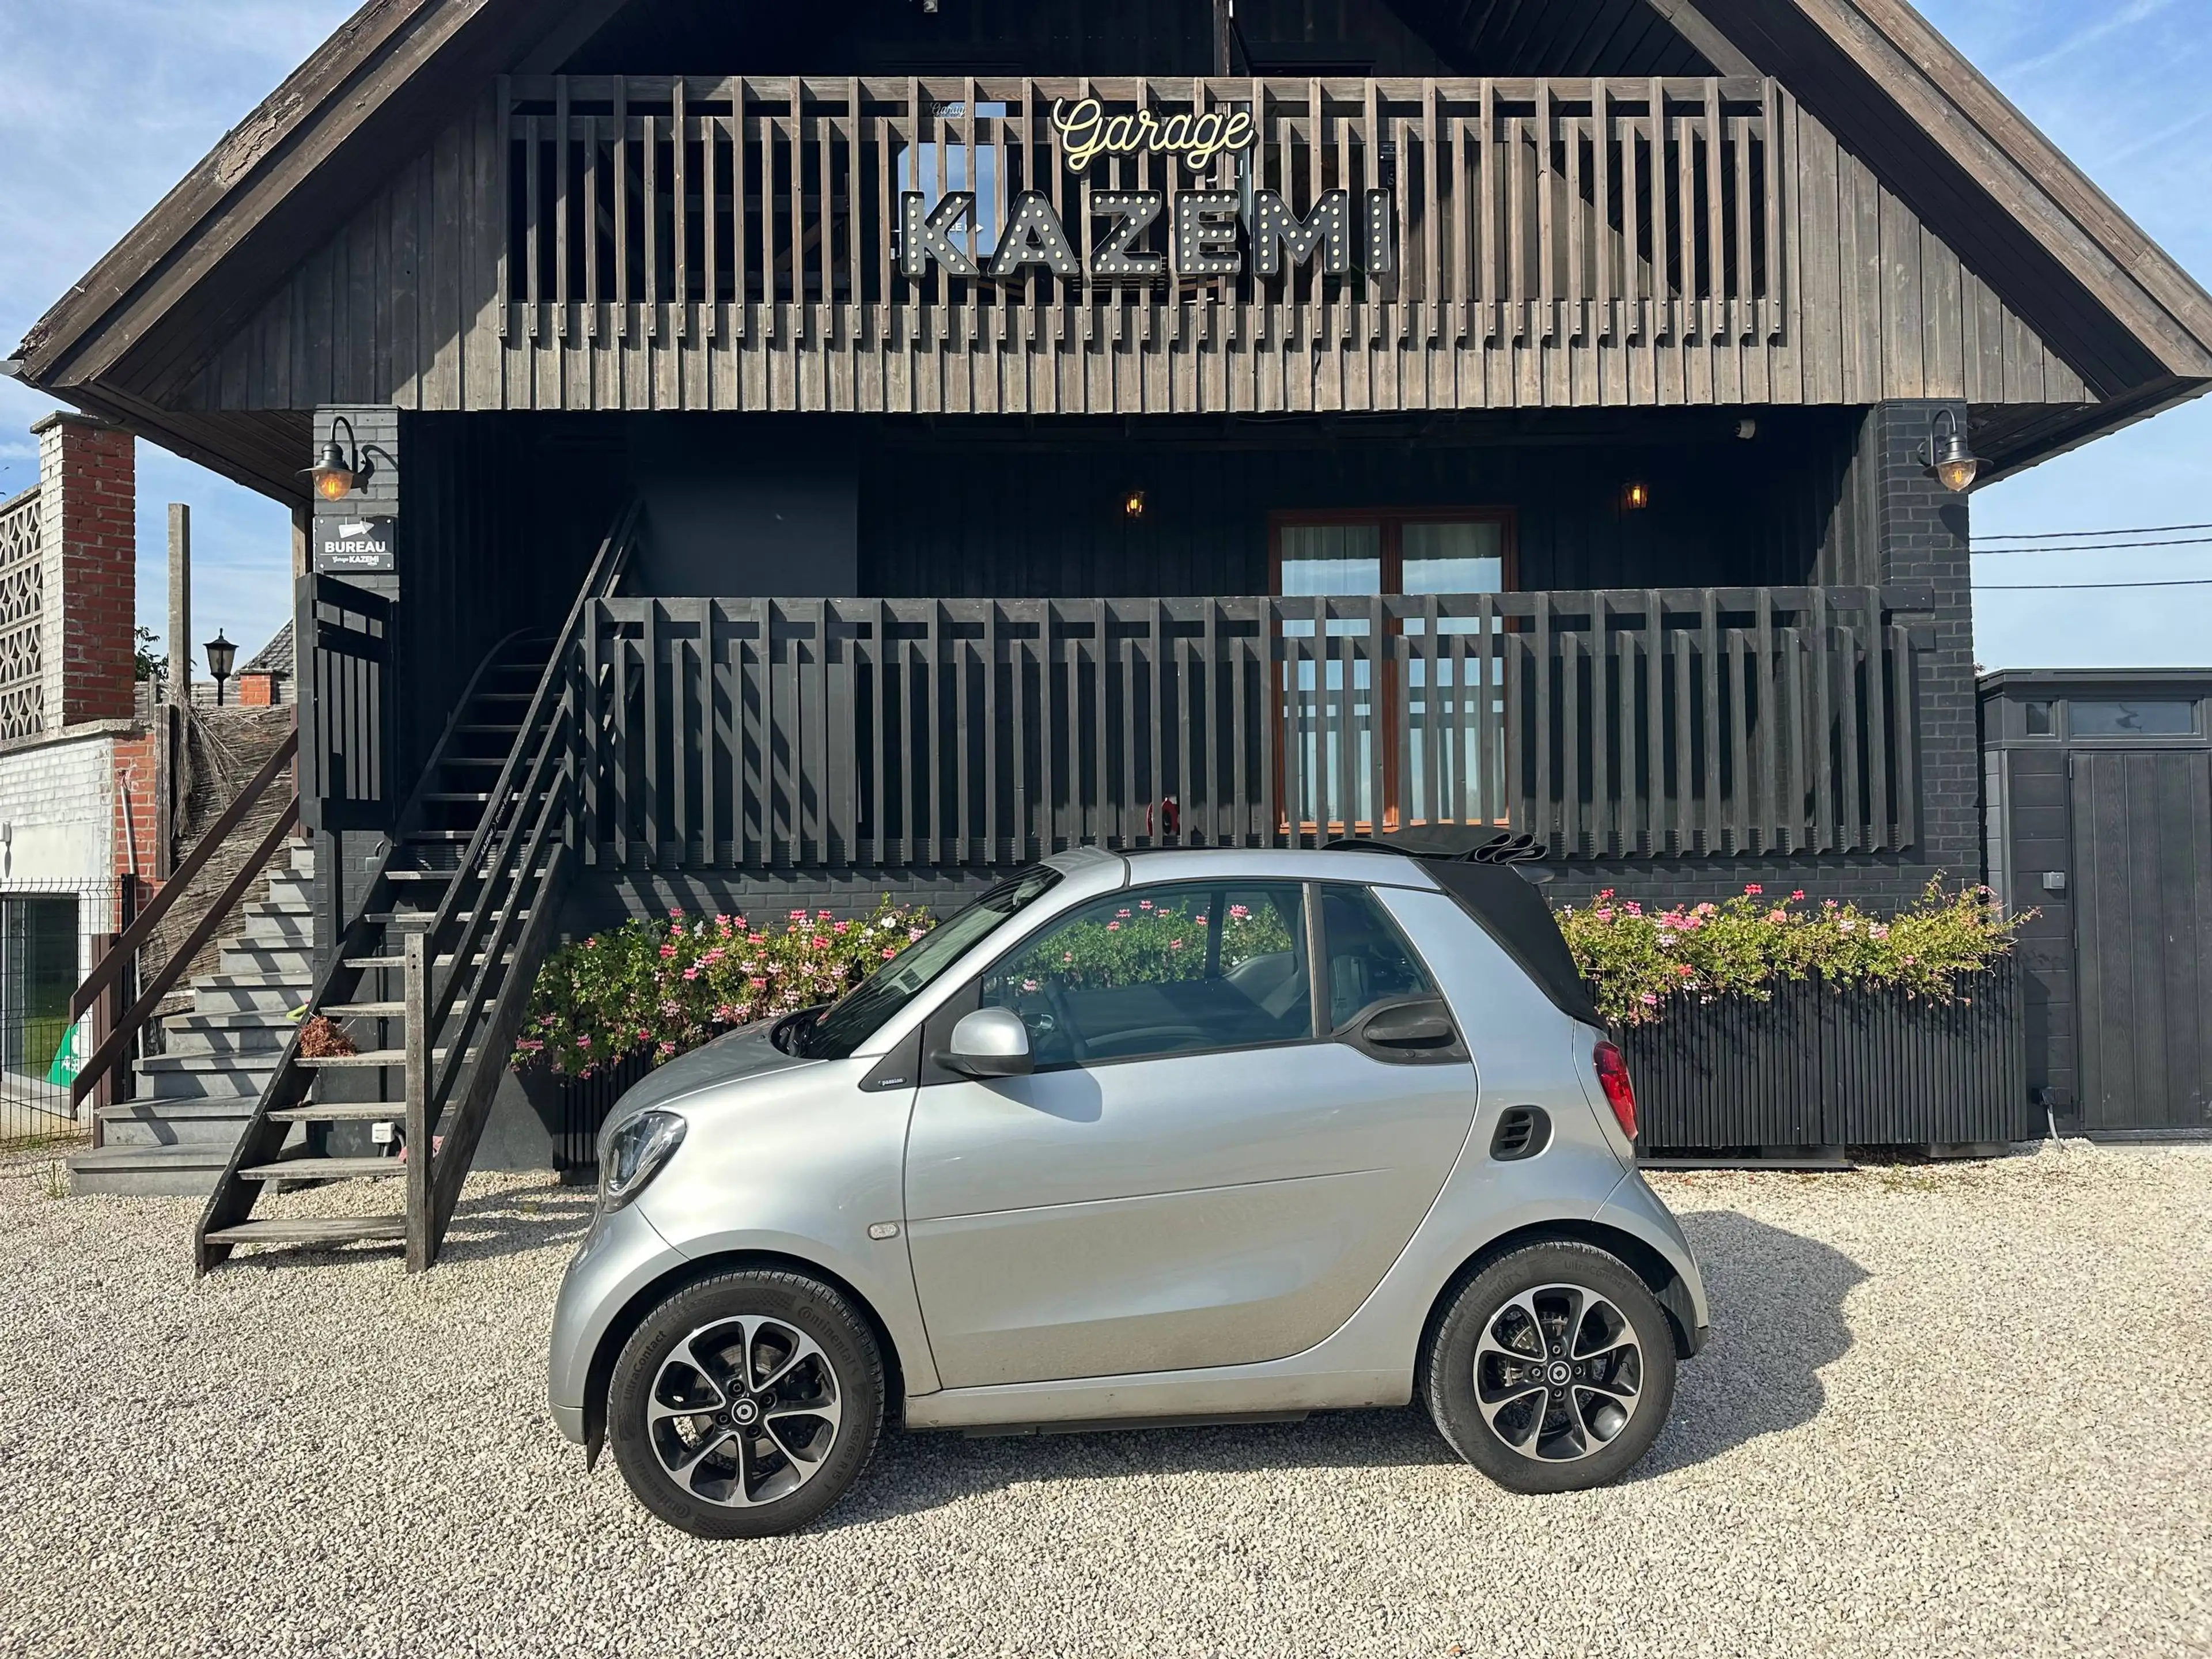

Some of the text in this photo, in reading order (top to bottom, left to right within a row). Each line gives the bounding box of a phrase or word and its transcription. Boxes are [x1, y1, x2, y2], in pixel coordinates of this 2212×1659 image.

[930, 102, 967, 119] Garag
[1054, 96, 1254, 171] Garage
[900, 189, 1390, 277] KAZEMI
[324, 541, 386, 553] BUREAU
[623, 1330, 667, 1400] UltraContact
[797, 1305, 855, 1366] Continental
